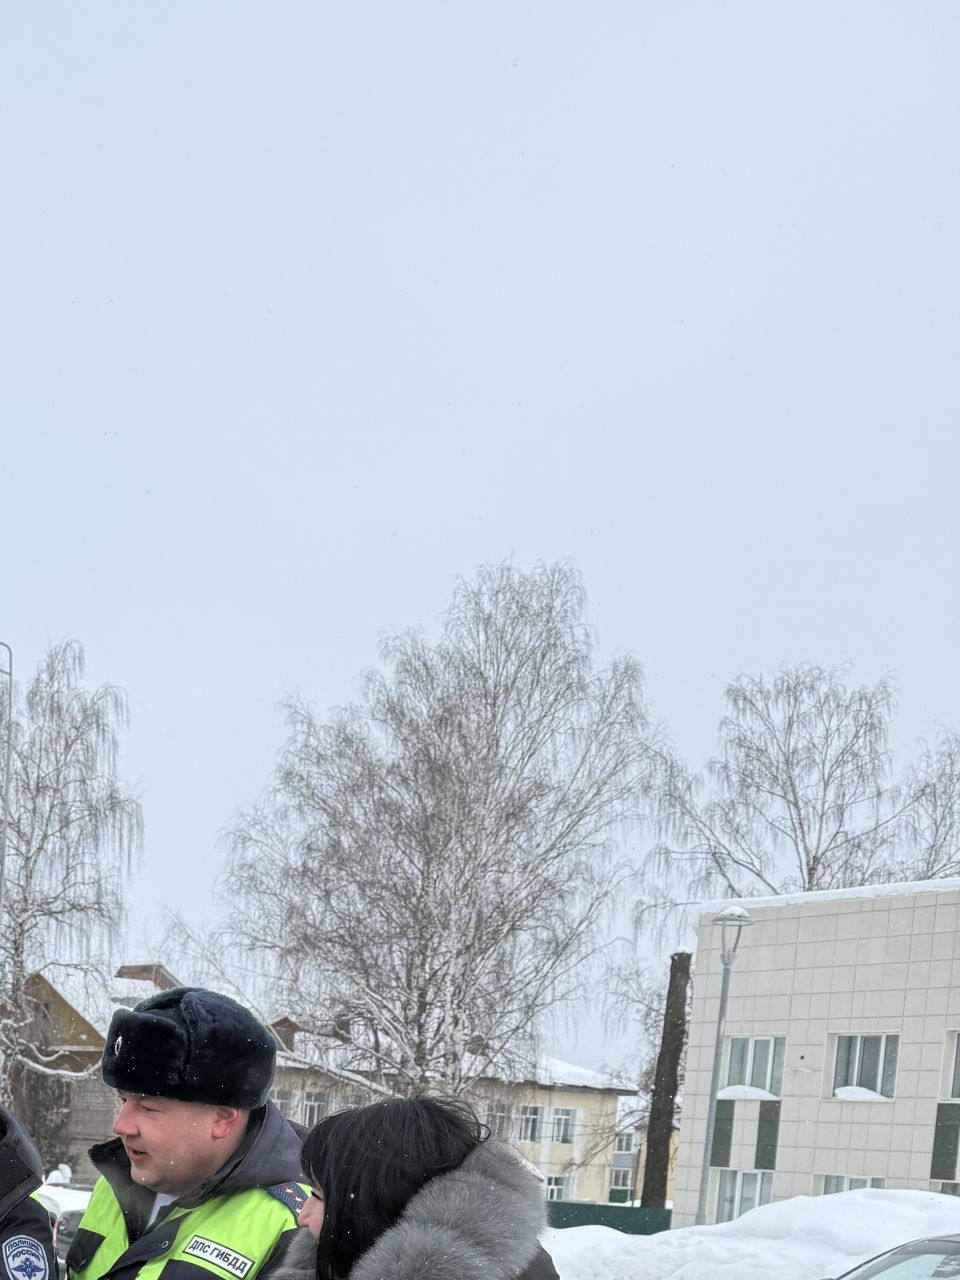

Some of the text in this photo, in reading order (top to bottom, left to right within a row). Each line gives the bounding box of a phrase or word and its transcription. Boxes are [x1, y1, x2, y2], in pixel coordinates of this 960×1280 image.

[7, 1239, 40, 1253] ПОЛИЦИЯ
[188, 1239, 248, 1274] ДПС ГИБДД
